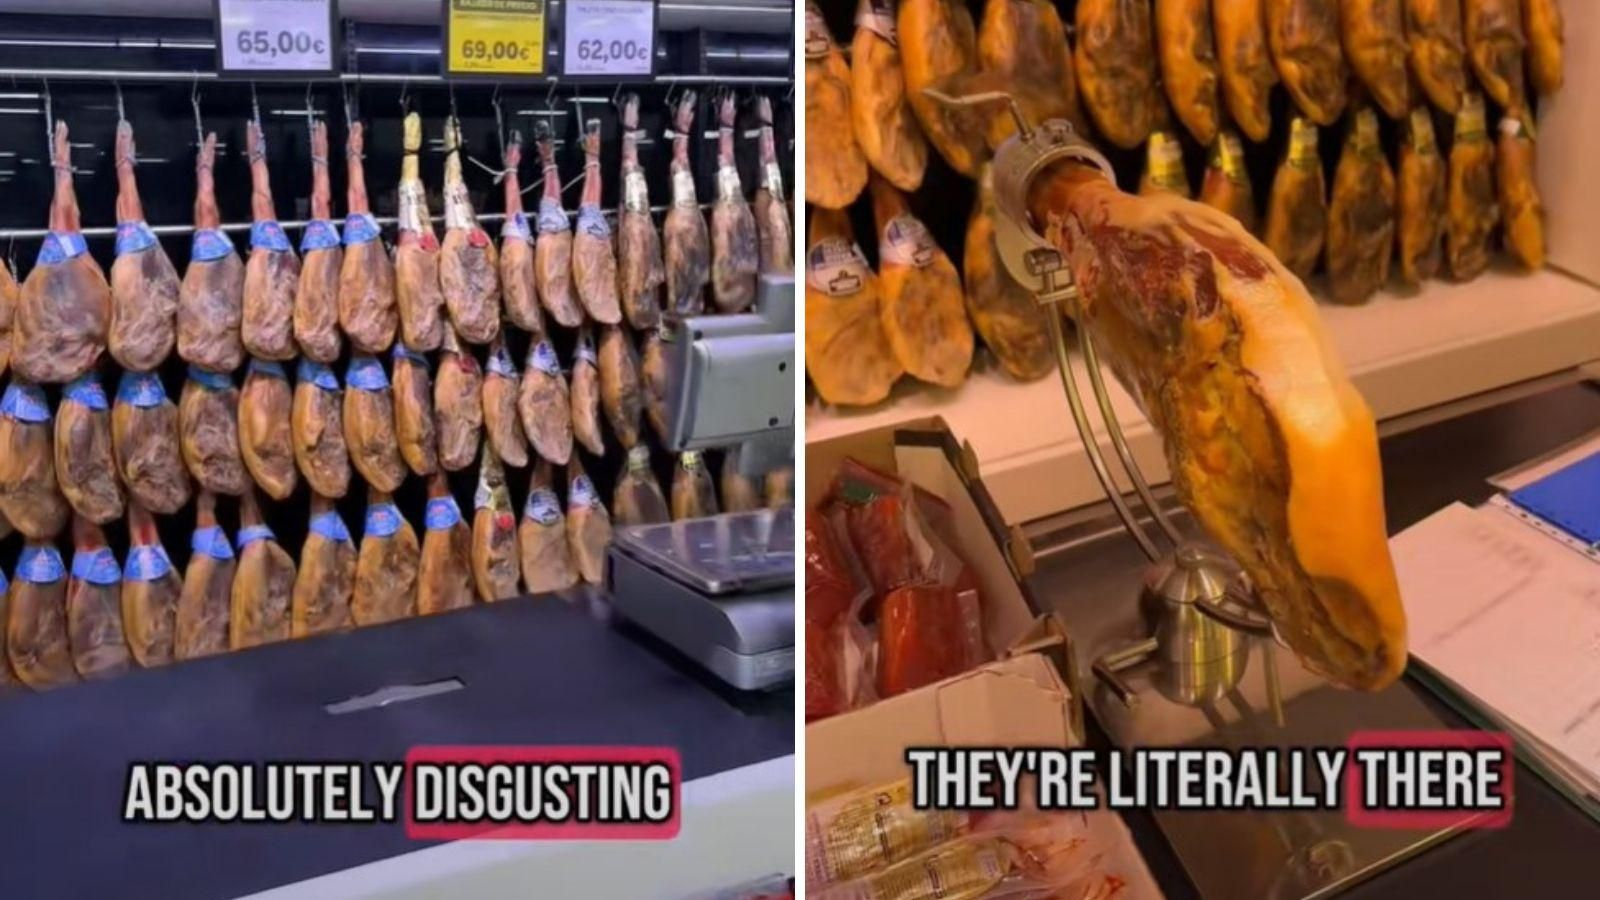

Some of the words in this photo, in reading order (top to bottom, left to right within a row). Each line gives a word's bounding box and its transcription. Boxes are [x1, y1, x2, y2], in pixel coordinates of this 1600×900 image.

[237, 30, 325, 58] 65,00€
[462, 39, 530, 62] 69,00€
[577, 39, 649, 64] 62,00€
